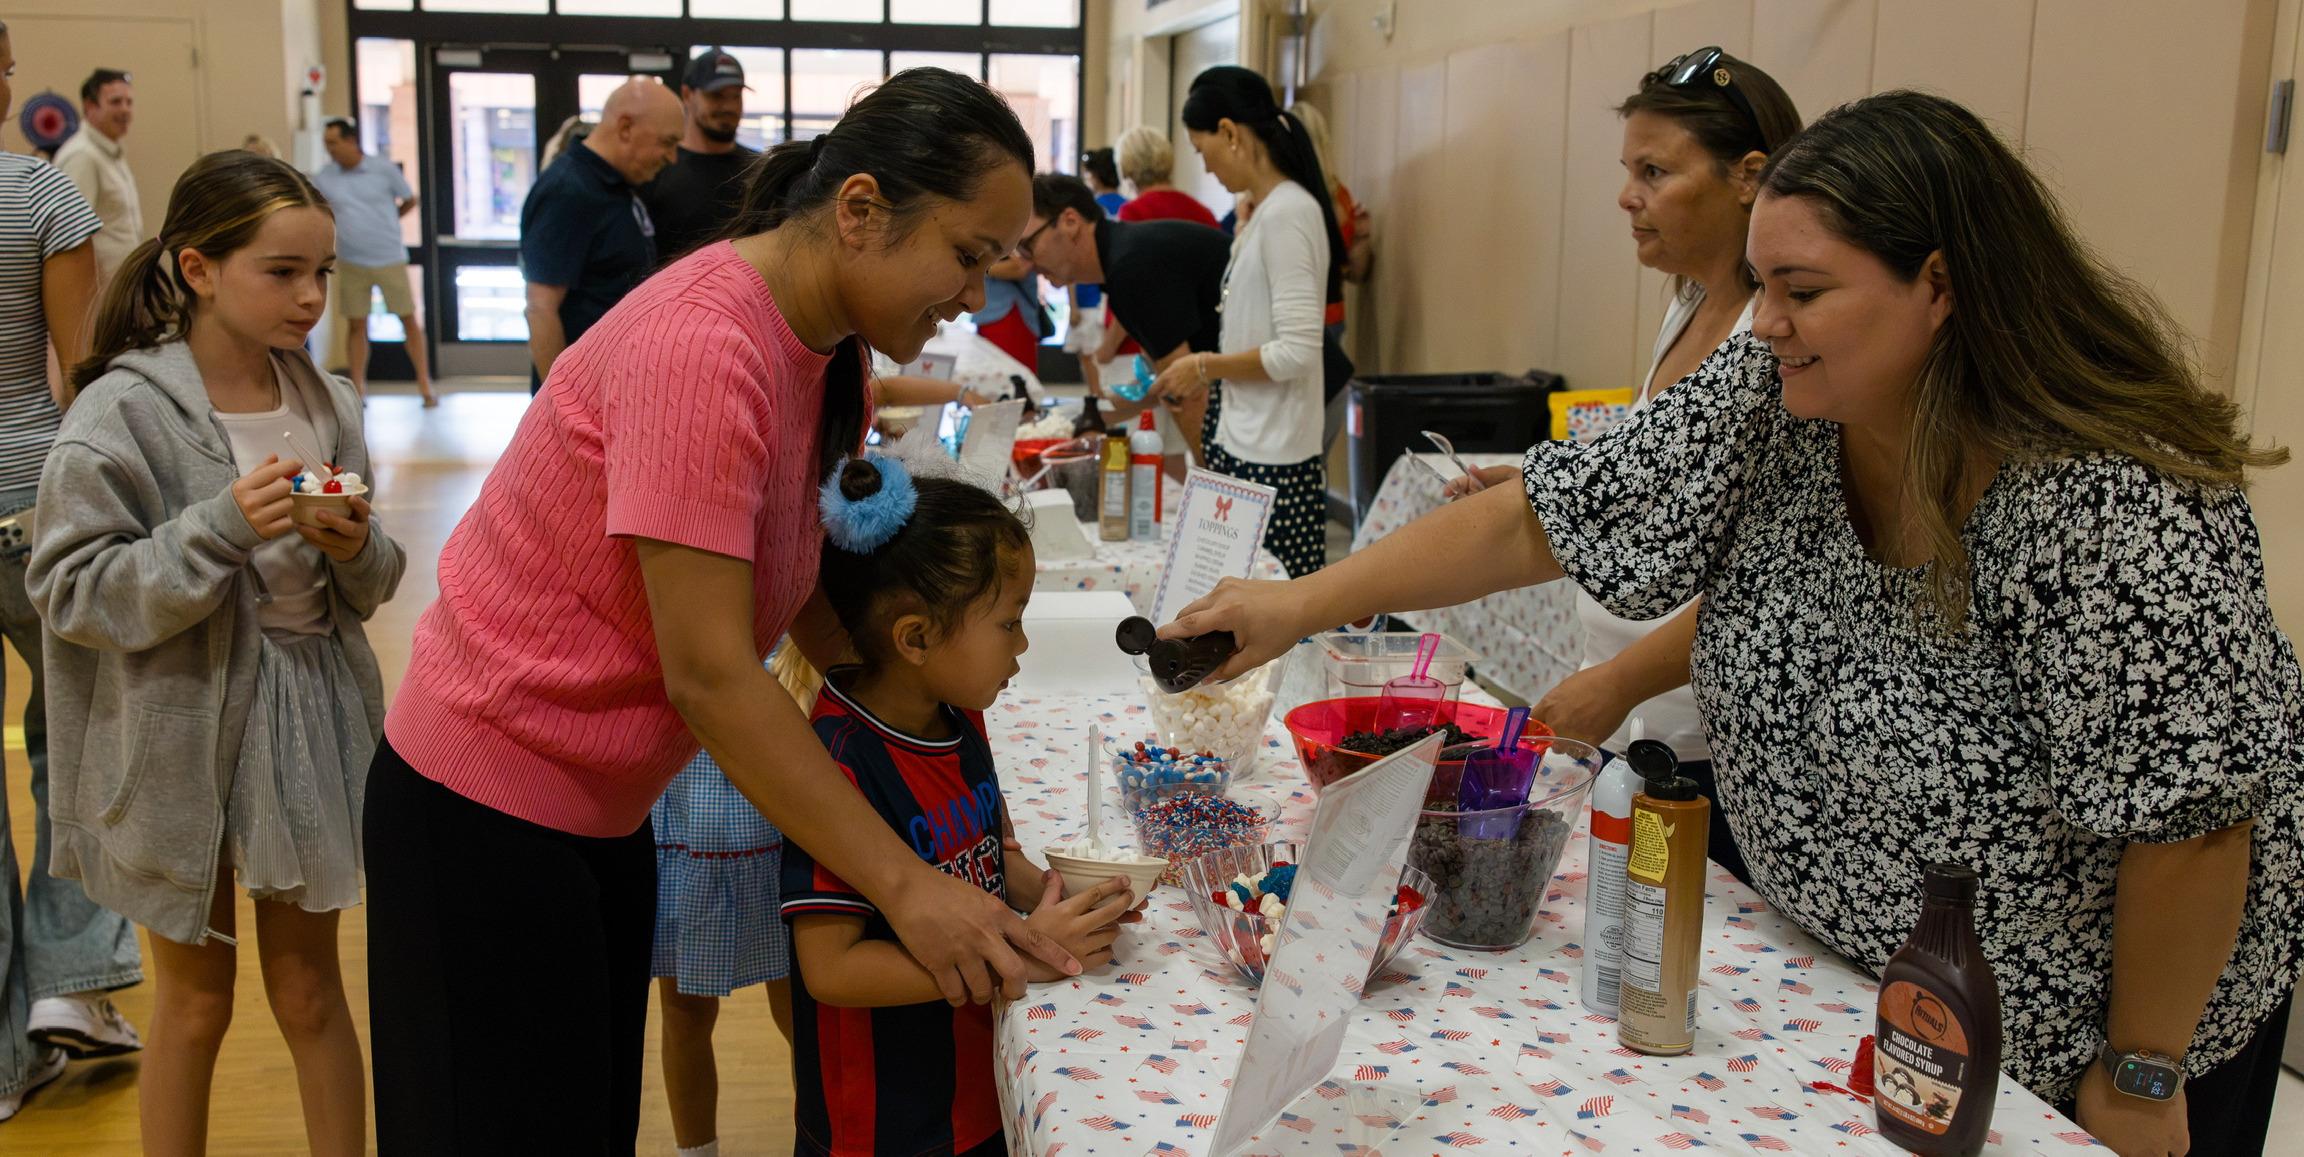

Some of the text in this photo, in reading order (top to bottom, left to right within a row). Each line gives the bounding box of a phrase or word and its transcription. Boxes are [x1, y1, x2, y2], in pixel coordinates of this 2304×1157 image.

[1199, 518, 1239, 539] TOPPINGS
[1915, 1004, 1944, 1033] RITUALS
[1883, 1038, 1915, 1065] FLAVORED
[1915, 1056, 1943, 1077] SYRUP
[1892, 1030, 1933, 1060] CHOCOLATE
